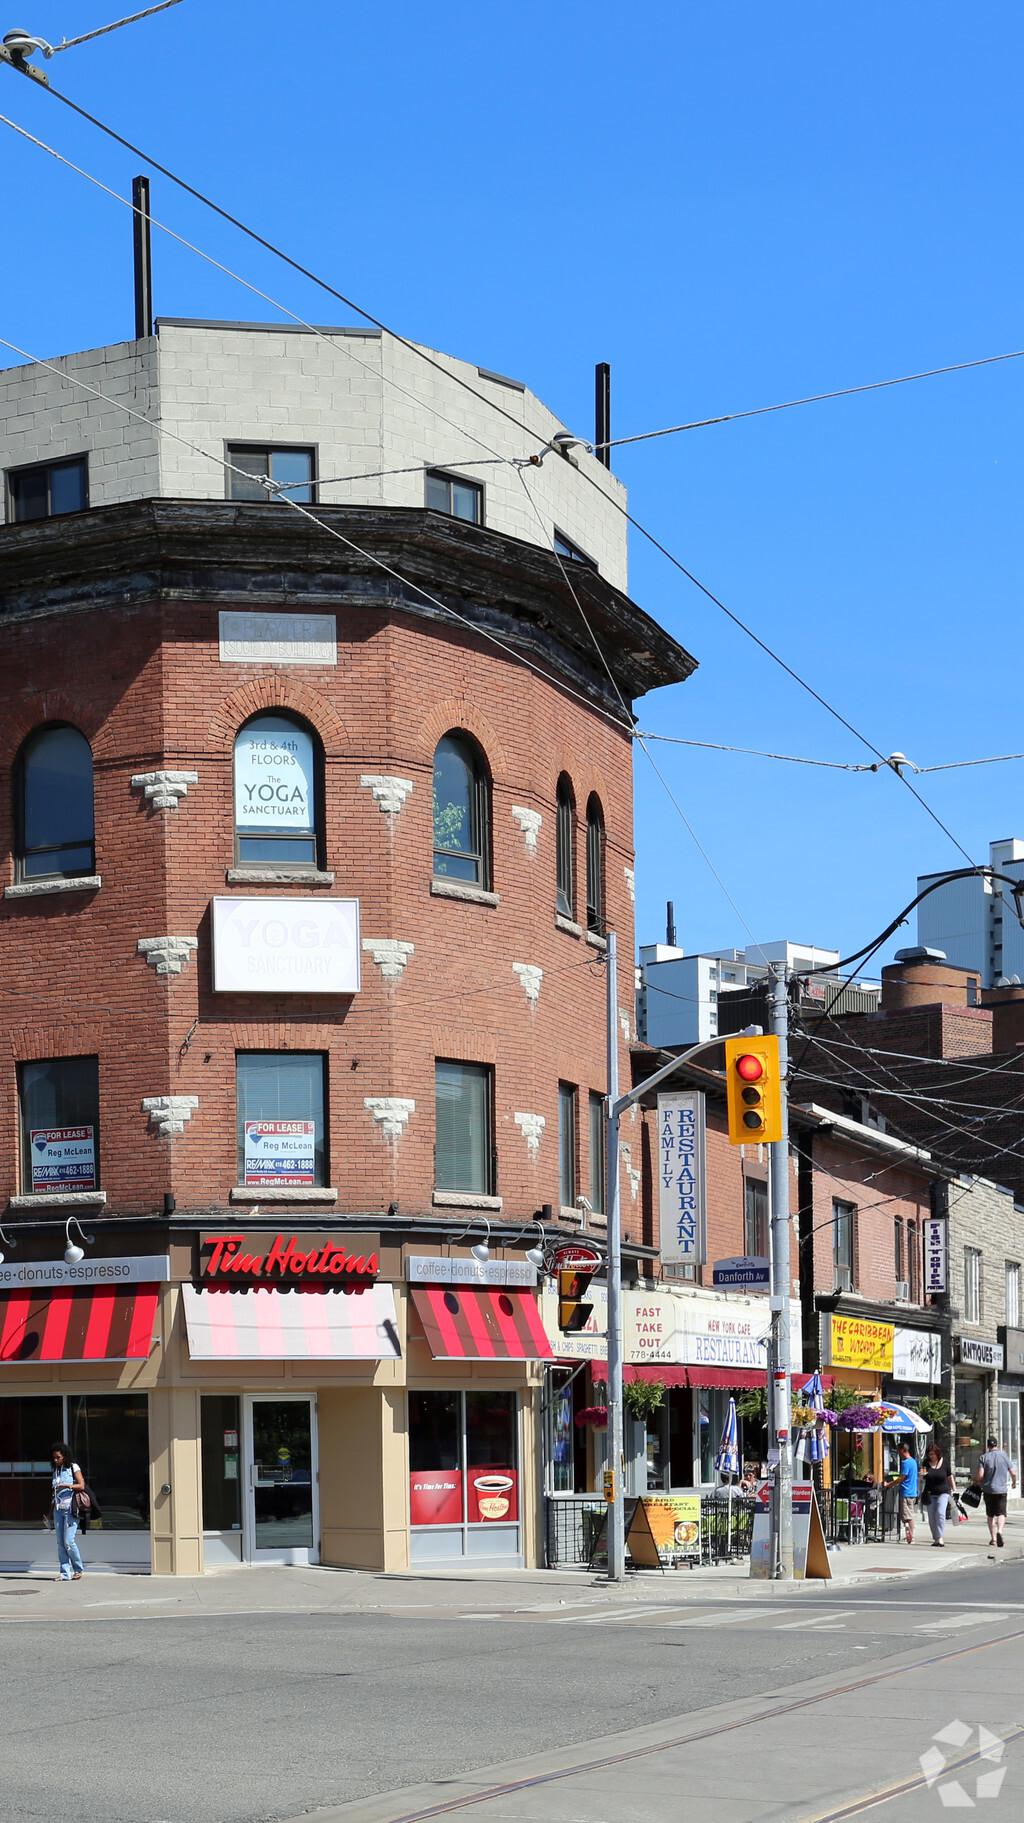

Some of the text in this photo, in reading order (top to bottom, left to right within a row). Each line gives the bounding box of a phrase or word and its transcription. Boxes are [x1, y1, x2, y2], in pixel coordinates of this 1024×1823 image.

[249, 740, 298, 751] 3rd & 4th
[251, 754, 296, 765] FLOORS
[267, 775, 281, 783] The
[244, 784, 305, 802] YOGA
[242, 804, 306, 815] SANCTUARY
[231, 919, 351, 949] YOGA
[247, 955, 332, 974] SANCTUARY
[258, 1123, 302, 1132] FOR LEASE
[47, 1132, 62, 1140] FOR
[63, 1130, 85, 1138] LEASE
[263, 1142, 279, 1151] Reg
[661, 1110, 675, 1188] FAMILY
[48, 1147, 92, 1158] Reg McLean
[677, 1109, 696, 1253] RESTAURANT
[205, 1234, 378, 1274] Tim Hortons
[718, 1271, 764, 1282] Danforth Av
[636, 1308, 661, 1317] FAST
[636, 1323, 663, 1333] TAKE
[708, 1319, 720, 1332] NEW
[722, 1321, 736, 1334] YORK
[832, 1319, 892, 1341] THE CARIBBEAN
[562, 1340, 574, 1352] CHIPS
[576, 1342, 598, 1354] SPAGHETTI
[639, 1338, 661, 1348] OUT
[630, 1350, 672, 1359] 778-4444
[696, 1337, 764, 1364] RESTAURANT
[963, 1341, 993, 1364] ANTIQUES
